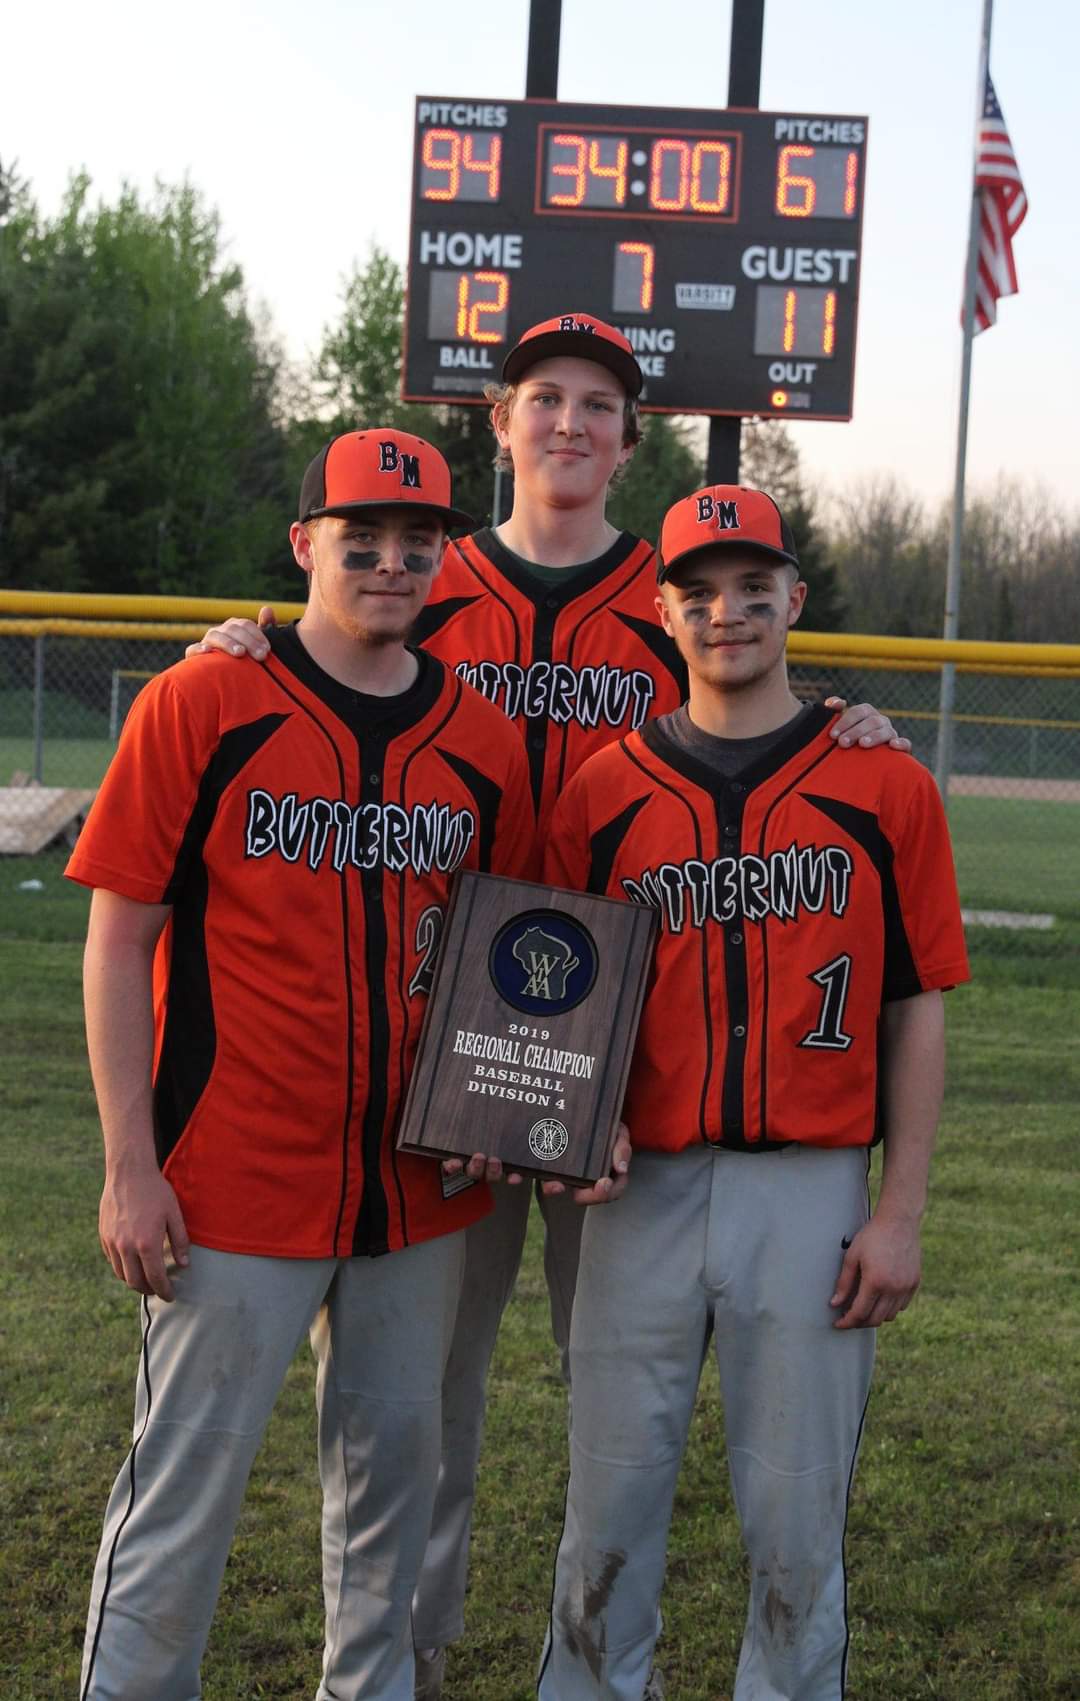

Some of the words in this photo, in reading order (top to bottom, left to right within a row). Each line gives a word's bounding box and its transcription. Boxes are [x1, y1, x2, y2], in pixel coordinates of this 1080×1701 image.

[418, 102, 508, 127] PITCHES
[775, 119, 865, 144] PITCHES
[422, 129, 502, 200] 94
[549, 134, 731, 213] 34:00
[776, 145, 858, 217] 61
[420, 231, 523, 268] HOME
[741, 246, 857, 283] GUEST
[617, 242, 655, 311] 7
[456, 271, 509, 343] 12
[782, 289, 836, 354] 11
[440, 347, 493, 369] BALL
[768, 362, 817, 384] OUT
[378, 441, 422, 489] BM
[696, 495, 741, 530] BM
[246, 788, 475, 877] BUTTERNUT
[799, 953, 854, 1050] 1
[508, 1023, 550, 1041] 2019
[453, 1030, 521, 1066] REGIONAL
[523, 1043, 595, 1080] CHAMPION
[467, 1080, 550, 1107] DIVISION
[555, 1098, 566, 1111] 4
[474, 1064, 565, 1093] BASEBALL
